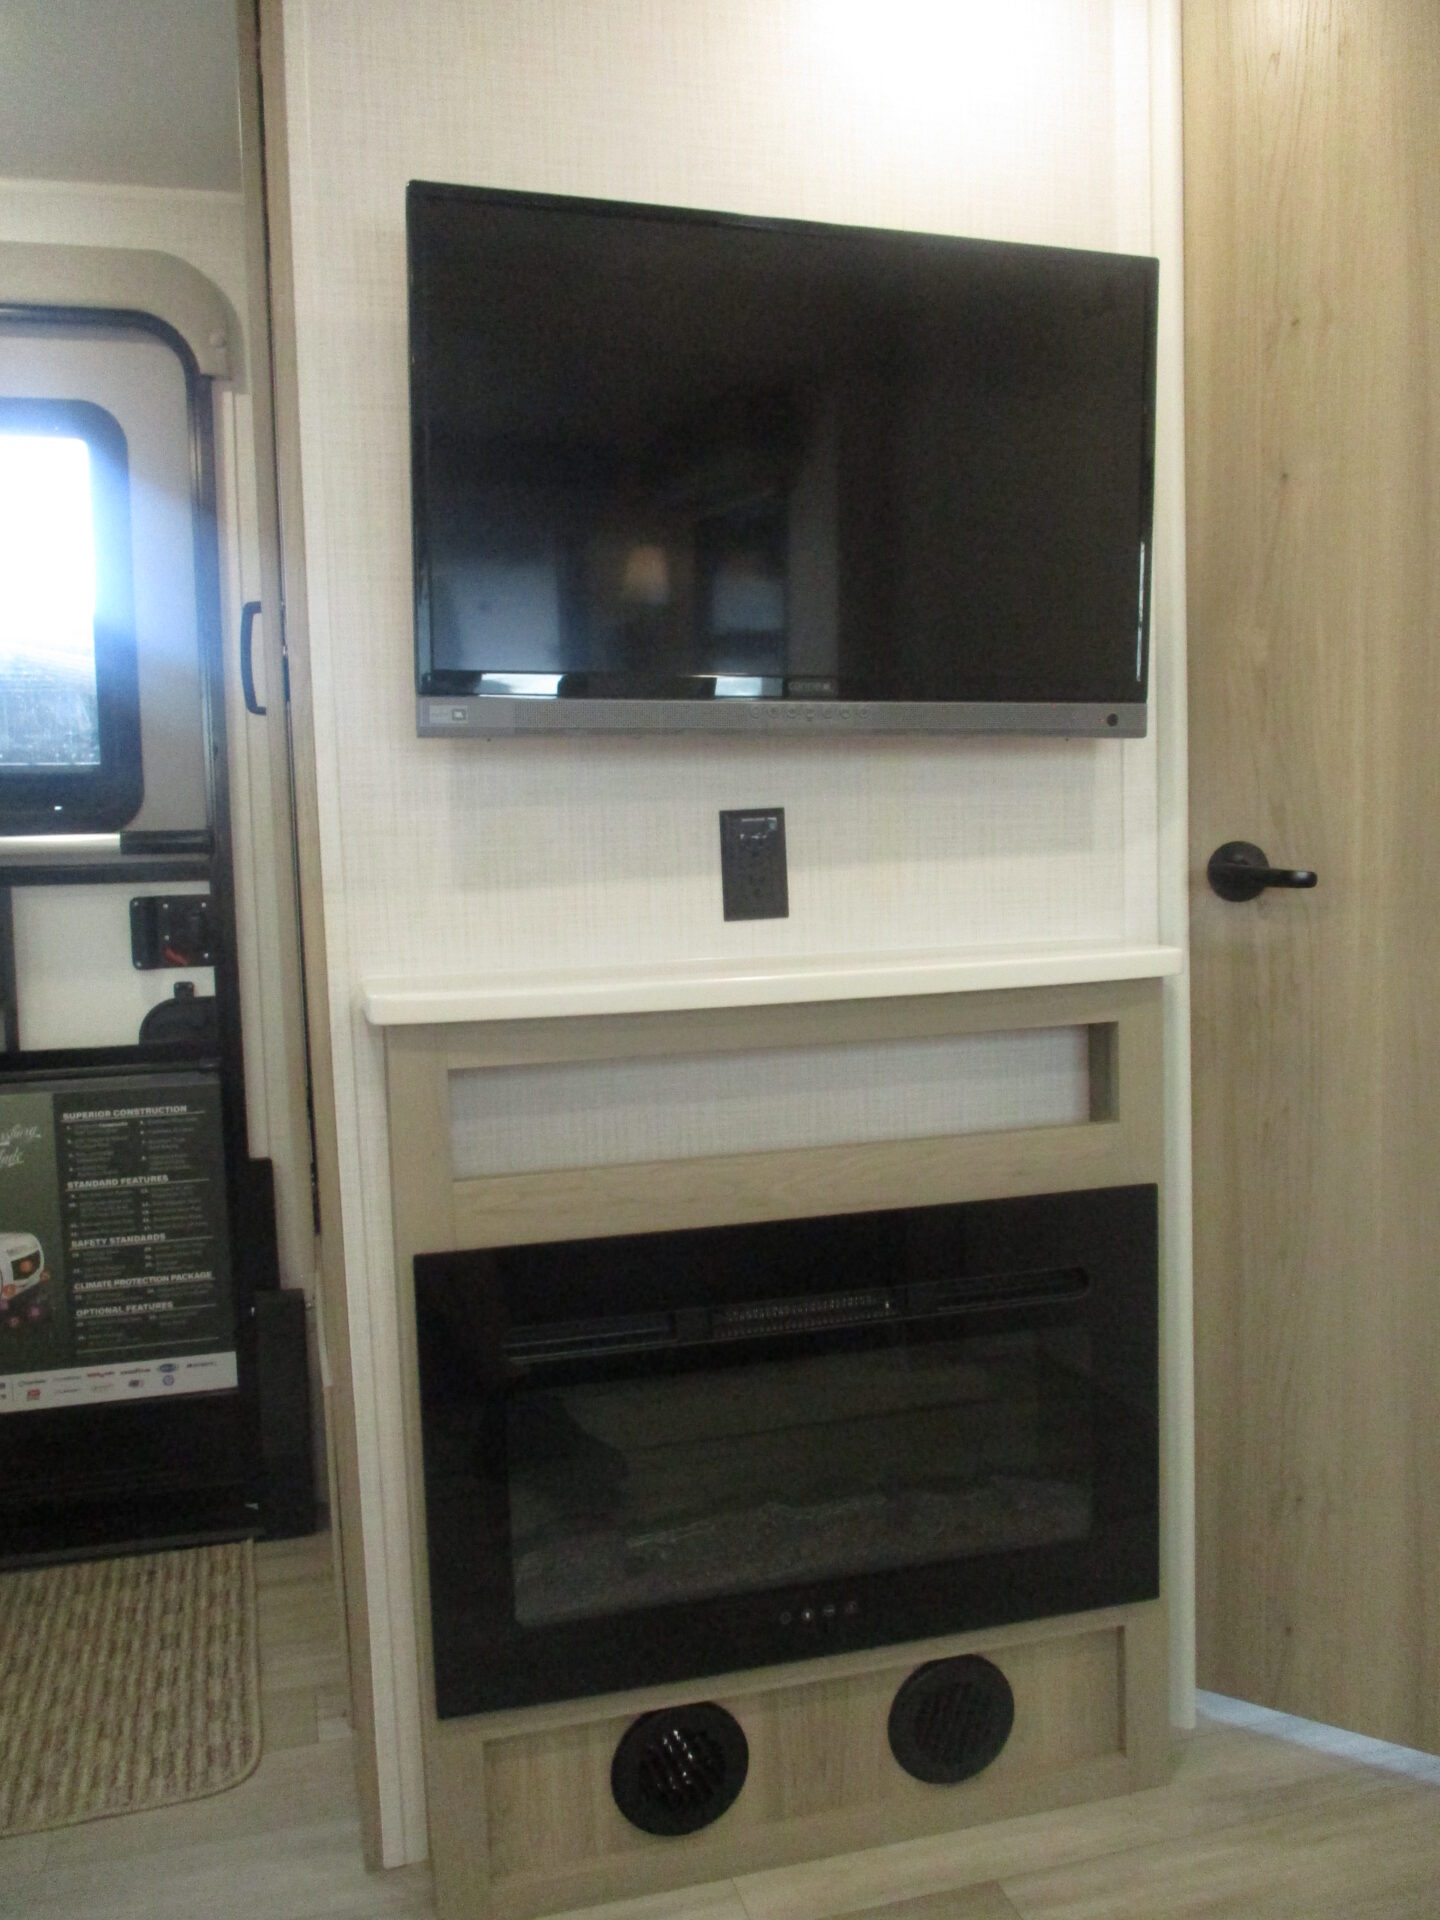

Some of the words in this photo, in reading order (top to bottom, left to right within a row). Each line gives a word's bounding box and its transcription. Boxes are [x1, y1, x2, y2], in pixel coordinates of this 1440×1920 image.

[62, 1111, 111, 1121] SUPERIOR
[113, 1105, 188, 1116] CONSTRUCTION
[67, 1179, 119, 1189] STANDARD
[120, 1174, 169, 1184] FEATURES
[71, 1238, 108, 1248] SAFETY
[110, 1233, 166, 1244] STANDARDS
[74, 1280, 111, 1290] CLIMATE
[114, 1275, 170, 1286] PROTECTION
[171, 1271, 212, 1281] PACKAGE
[76, 1307, 124, 1317] OPTIONAL
[126, 1301, 173, 1312] FEATURES
